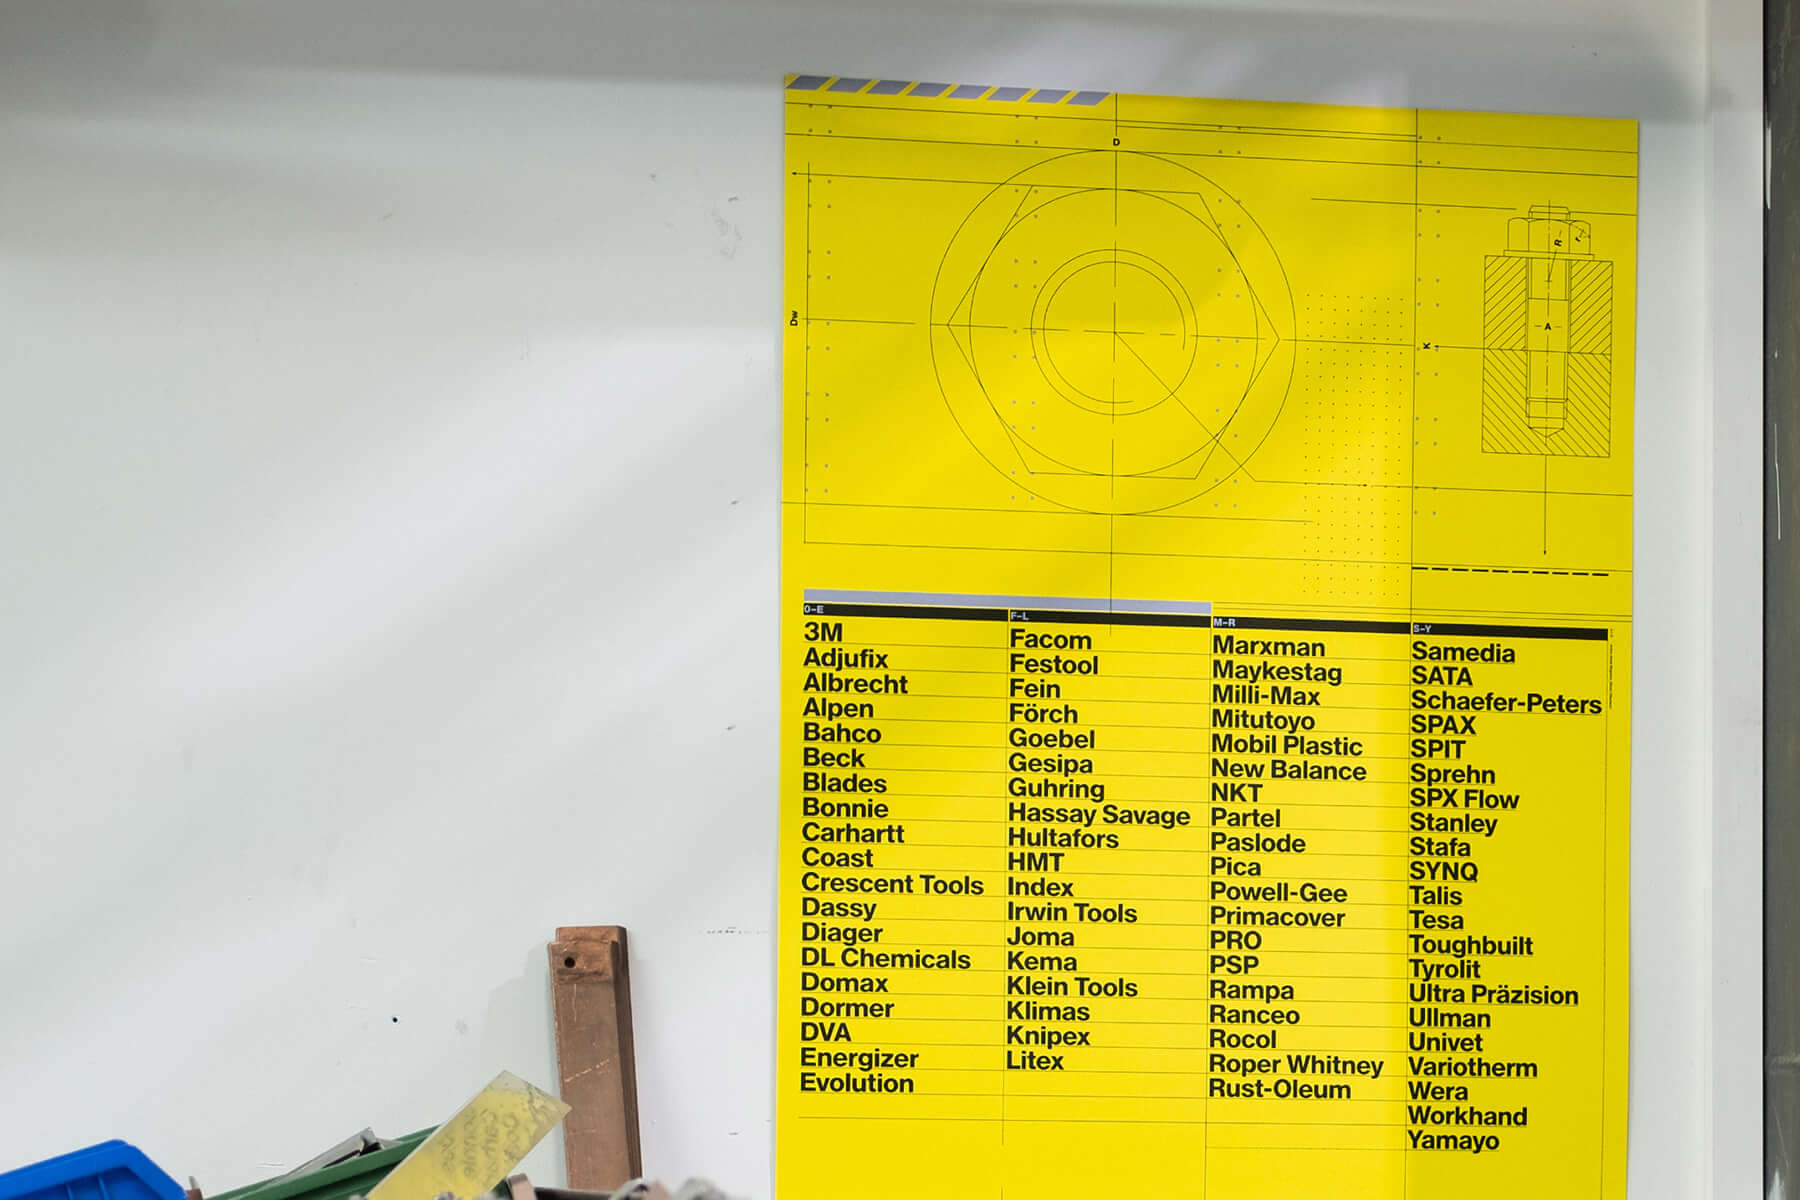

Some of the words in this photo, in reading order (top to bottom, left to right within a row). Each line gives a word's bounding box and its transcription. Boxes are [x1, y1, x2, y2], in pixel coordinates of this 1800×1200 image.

[1112, 138, 1120, 146] D
[1554, 239, 1562, 247] R
[1544, 322, 1552, 331] A
[1423, 342, 1431, 350] K
[804, 621, 843, 642] 3M
[1010, 628, 1092, 650] Facom
[1213, 634, 1325, 657] Marxman
[1412, 640, 1516, 663] Samedia
[803, 647, 889, 672] Adjufix
[1010, 653, 1098, 675] Festool
[803, 672, 908, 694] Albrecht
[1213, 659, 1342, 687] Maykestag
[1411, 665, 1473, 686] SATA
[1009, 678, 1061, 699] Fein
[1212, 683, 1321, 706] Milli-Max
[802, 697, 874, 722] Alpen
[1009, 702, 1078, 724] Förch
[1411, 689, 1603, 715] Schaefer-Peters
[803, 721, 882, 744] Bahco
[1212, 708, 1315, 735] Mitutoyo
[1411, 713, 1476, 735] SPAX
[1009, 727, 1095, 749] Goebel
[1212, 733, 1277, 754] Mobil
[1283, 735, 1363, 756] Plastic
[1410, 738, 1467, 759] SPIT
[803, 746, 865, 768] Beck
[1008, 752, 1093, 778] Gesipa
[1211, 757, 1265, 778] New
[1271, 759, 1367, 781] Balance
[1410, 762, 1496, 787] Sprehn
[803, 771, 887, 794] Blades
[1008, 777, 1105, 803] Guhring
[1211, 782, 1263, 803] NKT
[802, 796, 889, 819] Bonnie
[1410, 787, 1458, 808] SPX
[1464, 789, 1520, 809] Flow
[1008, 802, 1097, 828] Hassay
[1102, 804, 1191, 830] Savage
[1211, 807, 1281, 828] Partel
[1410, 811, 1498, 838] Stanley
[801, 821, 905, 844] Carhartt
[1008, 826, 1119, 849] Hultafors
[1211, 831, 1306, 853] Paslode
[801, 846, 874, 868] Coast
[1410, 836, 1471, 857] Stafa
[1008, 851, 1065, 872] HMT
[1211, 856, 1261, 877] Pica
[1409, 860, 1479, 883] SYNQ
[801, 871, 914, 893] Crescent
[919, 874, 984, 895] Tools
[1008, 876, 1074, 897] Index
[1210, 881, 1348, 903] Powell-Gee
[1408, 885, 1463, 906] Talis
[802, 897, 877, 922] Dassy
[1008, 901, 1068, 921] Irwin
[1073, 902, 1138, 923] Tools
[1210, 905, 1346, 928] Primacover
[1408, 909, 1464, 930] Tesa
[802, 922, 884, 947] Diager
[1006, 926, 1074, 947] Joma
[1210, 930, 1262, 950] PRO
[1408, 934, 1534, 959] Toughbuilt
[801, 947, 836, 967] DL
[841, 947, 971, 970] Chemicals
[1007, 950, 1077, 972] Kema
[1210, 954, 1259, 975] PSP
[1408, 958, 1481, 983] Tyrolit
[801, 971, 889, 993] Domax
[1007, 975, 1068, 996] Klein
[1074, 977, 1138, 998] Tools
[1210, 979, 1294, 1004] Rampa
[1409, 983, 1465, 1003] Ultra
[1471, 984, 1579, 1006] Präzision
[801, 996, 895, 1018] Dormer
[1007, 1000, 1090, 1021] Klimas
[1209, 1004, 1300, 1025] Ranceo
[1409, 1007, 1491, 1028] Ullman
[801, 1021, 852, 1042] DVA
[1007, 1025, 1090, 1050] Knipex
[1209, 1028, 1277, 1049] Rocol
[1409, 1031, 1483, 1052] Univet
[800, 1047, 920, 1072] Energizer
[1006, 1050, 1064, 1071] Litex
[1209, 1053, 1282, 1078] Roper
[1286, 1054, 1384, 1079] Whitney
[1408, 1056, 1538, 1078] Variotherm
[800, 1072, 914, 1093] Evolution
[1209, 1078, 1351, 1099] Rust-Oleum
[1407, 1081, 1468, 1101] Wera
[1407, 1105, 1528, 1127] Workhand
[1407, 1129, 1500, 1154] Yamayo
